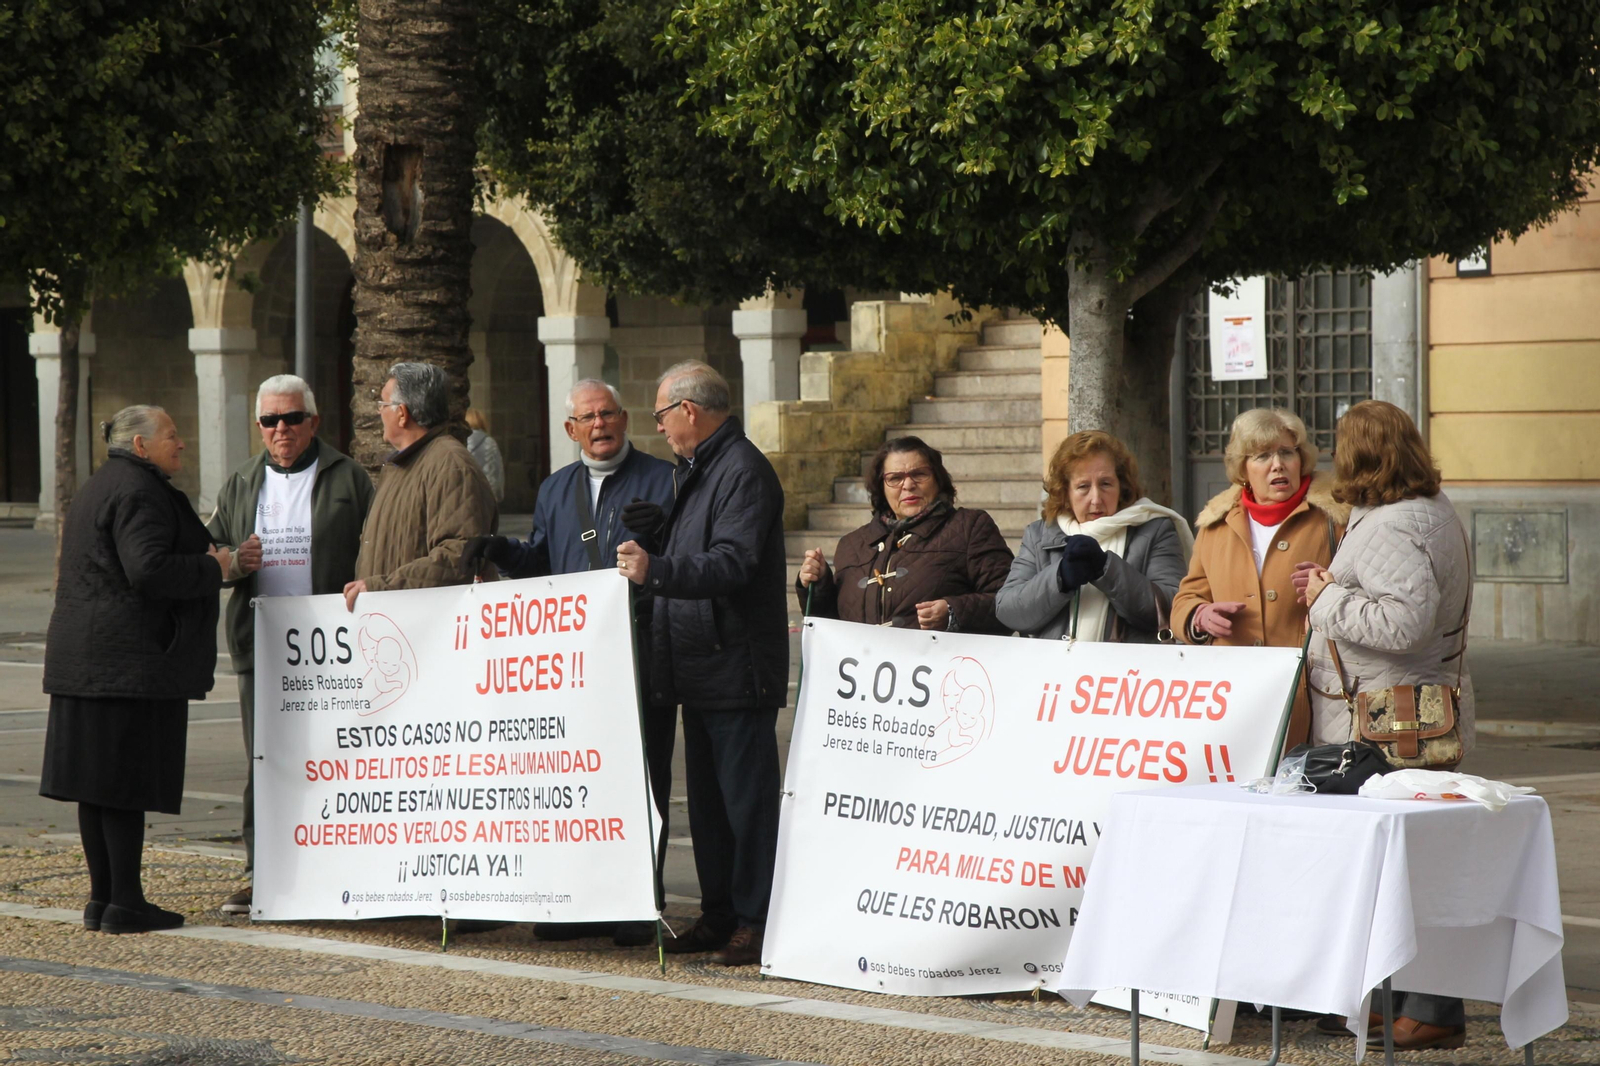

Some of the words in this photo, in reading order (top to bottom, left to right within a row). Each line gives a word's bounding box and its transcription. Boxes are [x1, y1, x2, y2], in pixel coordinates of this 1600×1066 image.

[294, 526, 304, 534] hija
[263, 559, 279, 568] padre
[288, 558, 306, 566] busca
[481, 593, 587, 639] SEÑORES
[285, 626, 352, 667] S.O.S
[282, 676, 313, 691] Bebés
[316, 675, 363, 690] Robados
[476, 653, 563, 695] JUECES
[572, 652, 584, 688] !!
[837, 658, 932, 707] S.O.S
[280, 699, 305, 711] Jerez
[308, 698, 318, 711] de
[321, 698, 328, 710] la
[332, 697, 371, 710] Frontera
[1071, 669, 1231, 721] SEÑORES
[337, 725, 397, 748] ESTOS
[403, 722, 451, 746] CASOS
[455, 721, 482, 742] NO
[489, 716, 565, 742] PRESCRIBEN
[828, 709, 866, 729] Bebés
[873, 714, 936, 737] Robados
[823, 734, 852, 750] Jerez
[857, 738, 869, 752] de
[873, 740, 882, 754] la
[887, 741, 937, 761] Frontera
[1054, 736, 1188, 783] JUECES
[1204, 744, 1235, 782] !!
[305, 760, 348, 782] SON
[356, 756, 428, 780] DELITOS
[433, 755, 451, 777] DE
[456, 754, 507, 776] LESA
[511, 749, 601, 775] HUMANIDAD
[337, 791, 392, 813] DONDE
[397, 783, 444, 813] ESTÁN
[447, 787, 529, 810] NUESTROS
[534, 786, 572, 809] HIJOS
[579, 786, 588, 808] ?
[294, 823, 397, 847] QUEREMOS
[404, 820, 467, 844] VERLOS
[473, 820, 529, 843] ANTES
[533, 820, 549, 842] DE
[555, 818, 625, 842] MORIR
[824, 792, 916, 827] PEDIMOS
[923, 805, 997, 841] VERDAD,
[1004, 815, 1087, 846] JUSTICIA
[412, 854, 479, 877] JUSTICIA
[487, 855, 509, 876] YA
[515, 855, 522, 876] !!
[896, 847, 949, 876] PARA
[955, 854, 1014, 884] MILES
[1021, 862, 1055, 888] DE
[352, 894, 364, 902] sos
[366, 891, 385, 902] bebes
[386, 891, 413, 902] robados
[415, 891, 432, 901] Jerez
[857, 889, 898, 916] QUE
[899, 895, 936, 921] LES
[939, 900, 1061, 930] ROBARON
[870, 960, 886, 974] sos
[887, 960, 916, 979] bebes
[918, 964, 965, 980] robados
[968, 964, 1001, 978] Jerez
